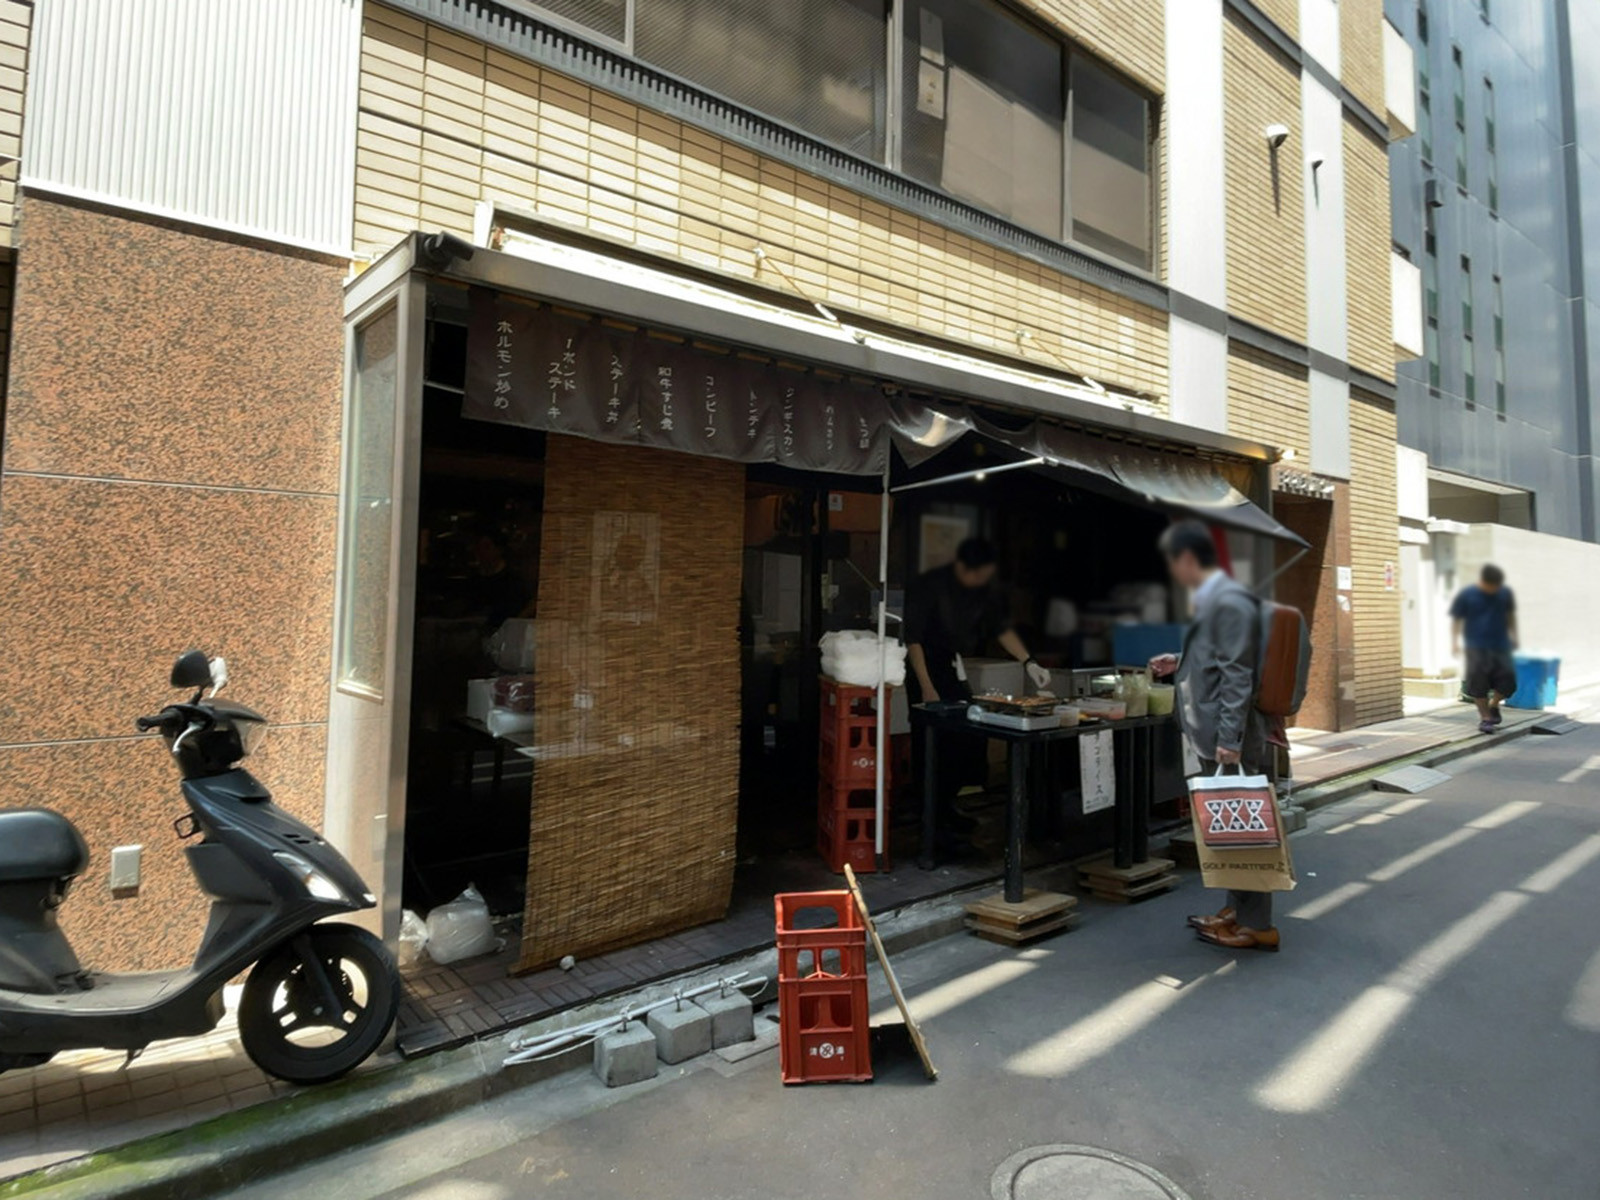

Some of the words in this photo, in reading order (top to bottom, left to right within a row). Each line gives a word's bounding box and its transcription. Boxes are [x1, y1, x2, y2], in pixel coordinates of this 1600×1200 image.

[547, 362, 563, 419] ステーキ
[1202, 861, 1226, 870] GOLF
[1229, 862, 1275, 871] PARTNER
